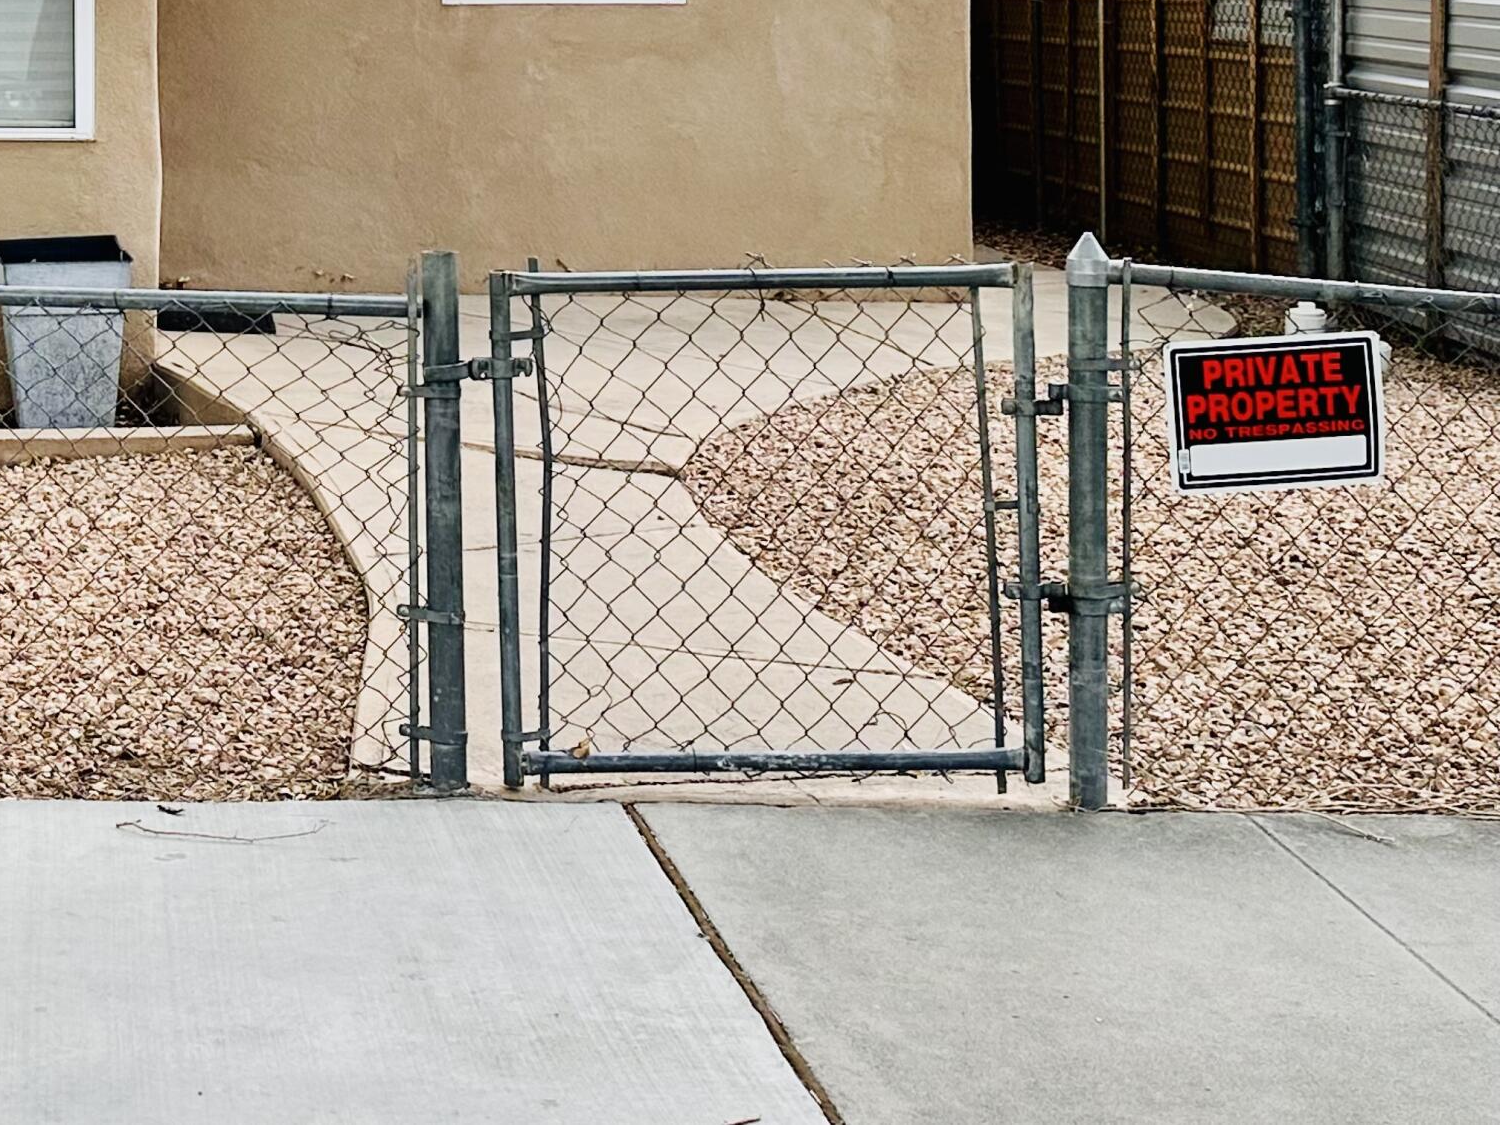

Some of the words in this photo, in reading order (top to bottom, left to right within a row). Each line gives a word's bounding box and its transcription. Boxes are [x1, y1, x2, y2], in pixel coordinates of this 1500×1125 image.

[1202, 351, 1344, 390] PRIVATE
[1186, 384, 1362, 424] PROPERTY
[1188, 428, 1218, 440] NO
[1224, 418, 1366, 439] TRESPASSING
